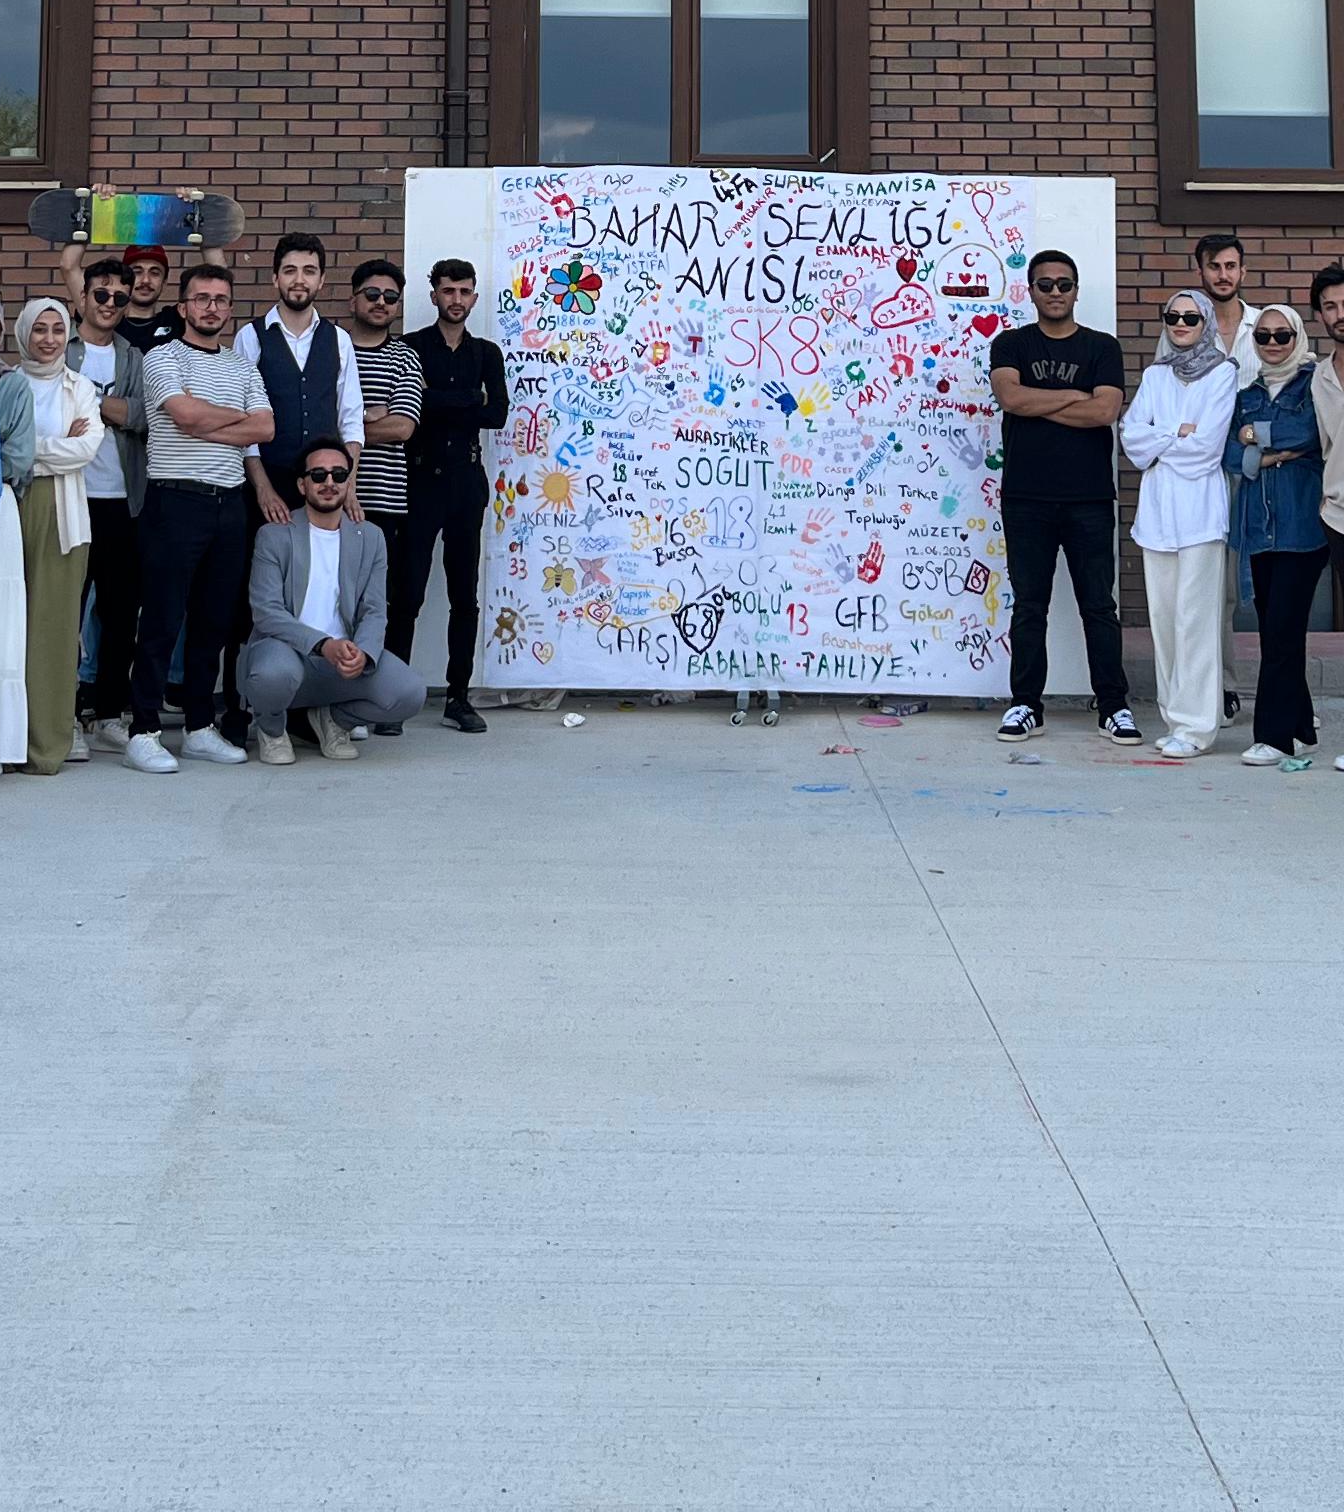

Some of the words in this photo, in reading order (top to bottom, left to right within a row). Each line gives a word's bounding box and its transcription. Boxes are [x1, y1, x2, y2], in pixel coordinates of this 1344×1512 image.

[947, 181, 1012, 198] FOCUS
[566, 200, 726, 256] BAHAR
[497, 288, 516, 314] 18
[537, 316, 556, 331] 05
[505, 349, 568, 366] ATATÜRK
[723, 315, 820, 377] SK8
[551, 367, 574, 386] FB
[598, 390, 613, 402] 53
[780, 453, 813, 478] PDR
[816, 481, 855, 501] Dünya
[897, 484, 938, 501] Türkçe
[520, 509, 580, 529] AKDENİZ
[767, 503, 786, 519] 41
[844, 510, 906, 531] Topluluğu
[664, 517, 686, 546] 16
[652, 545, 704, 567] Bursa
[732, 590, 782, 615] BOLU
[835, 594, 889, 633] GFB
[682, 608, 715, 640] 68
[786, 602, 809, 636] 13
[687, 649, 784, 681] BABALAR
